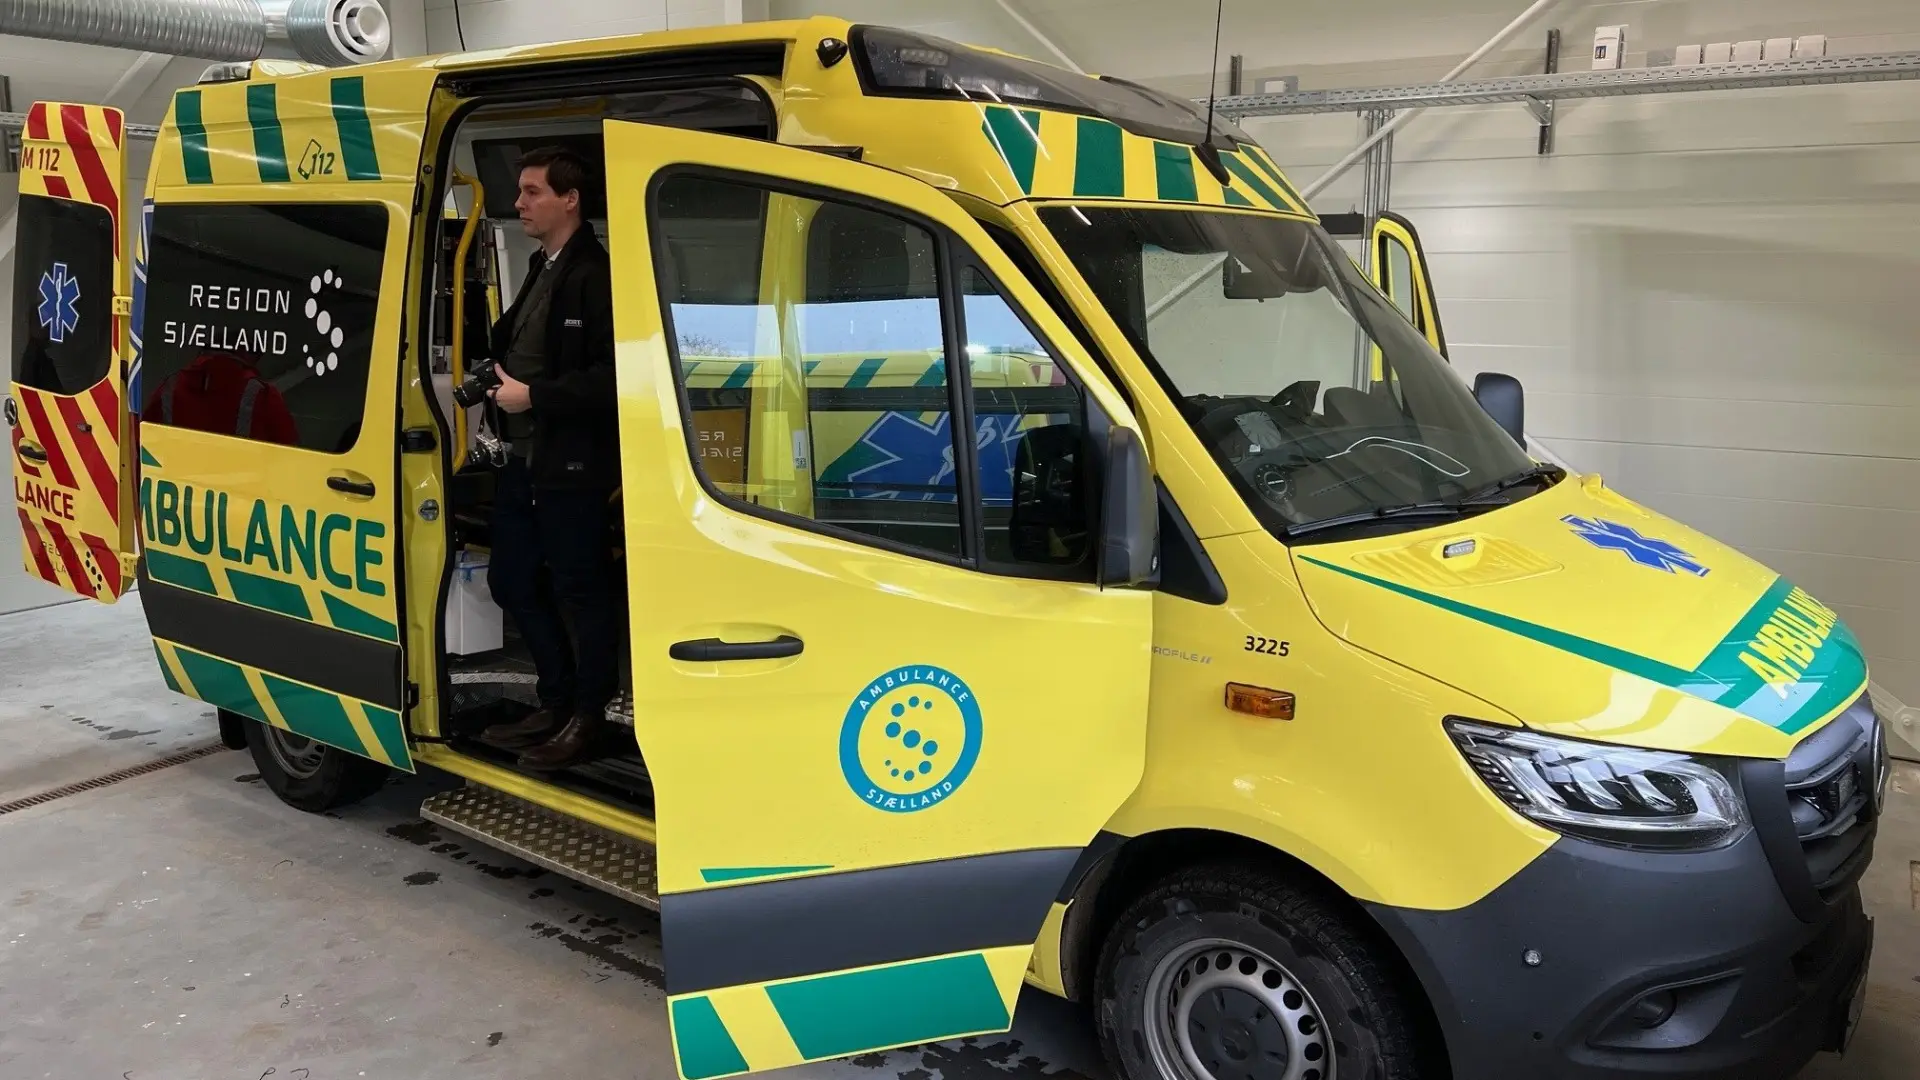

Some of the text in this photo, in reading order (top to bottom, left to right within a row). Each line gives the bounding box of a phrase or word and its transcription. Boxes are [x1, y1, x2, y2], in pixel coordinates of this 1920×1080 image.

[39, 148, 60, 171] 112
[312, 152, 335, 175] 112
[190, 285, 291, 314] REGION
[164, 321, 287, 355] SJÆLLAND
[14, 475, 75, 521] LANCE
[1153, 645, 1199, 662] ROFILE
[1244, 635, 1291, 657] 3225
[858, 669, 970, 711] AMBULANCE
[866, 781, 953, 809] SJÆLLAND
